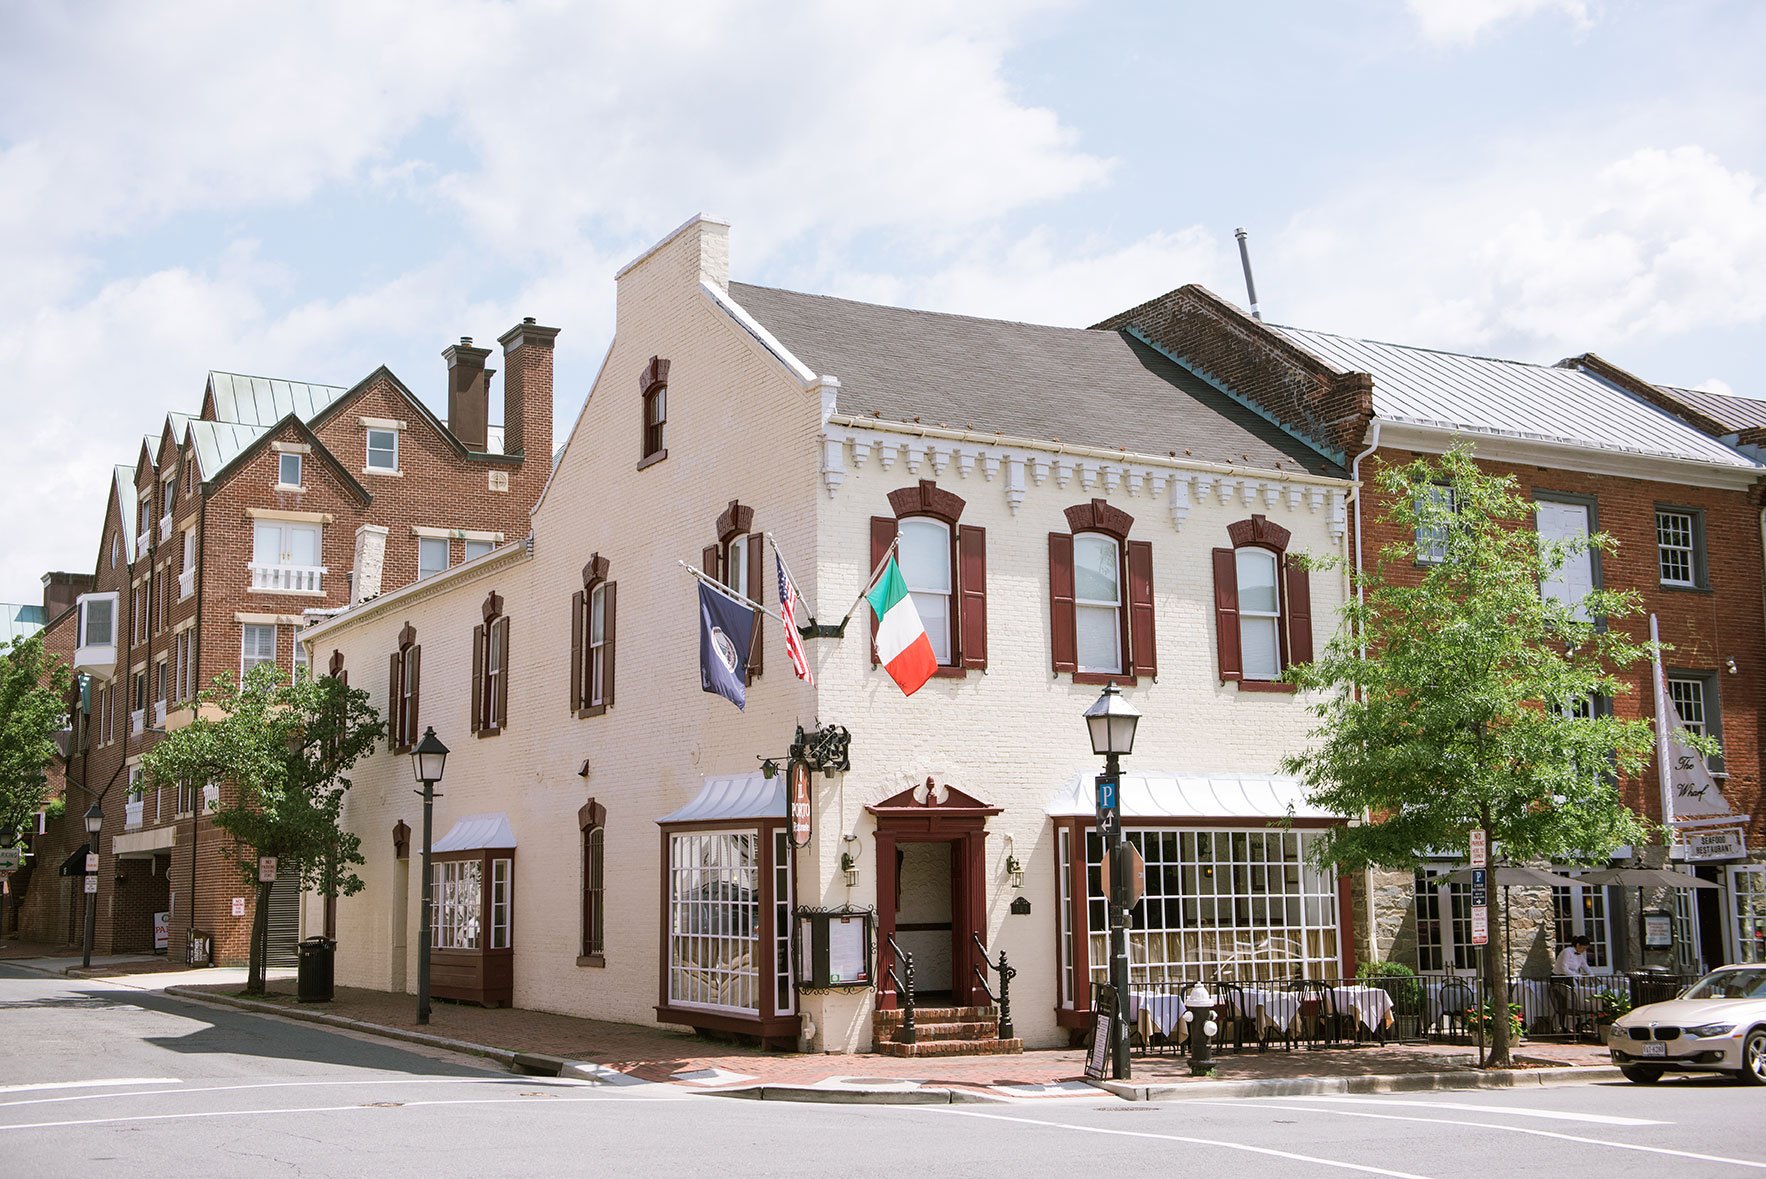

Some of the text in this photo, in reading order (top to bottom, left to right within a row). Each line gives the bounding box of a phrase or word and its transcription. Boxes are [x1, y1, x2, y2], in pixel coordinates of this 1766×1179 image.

[1675, 756, 1694, 770] The
[1102, 785, 1113, 807] P
[1677, 783, 1709, 801] Wharf
[791, 802, 811, 818] PORTO
[1701, 835, 1726, 845] SEAFOOD
[1695, 844, 1733, 855] RESTAURANT
[1476, 871, 1482, 883] P
[155, 926, 169, 934] PA
